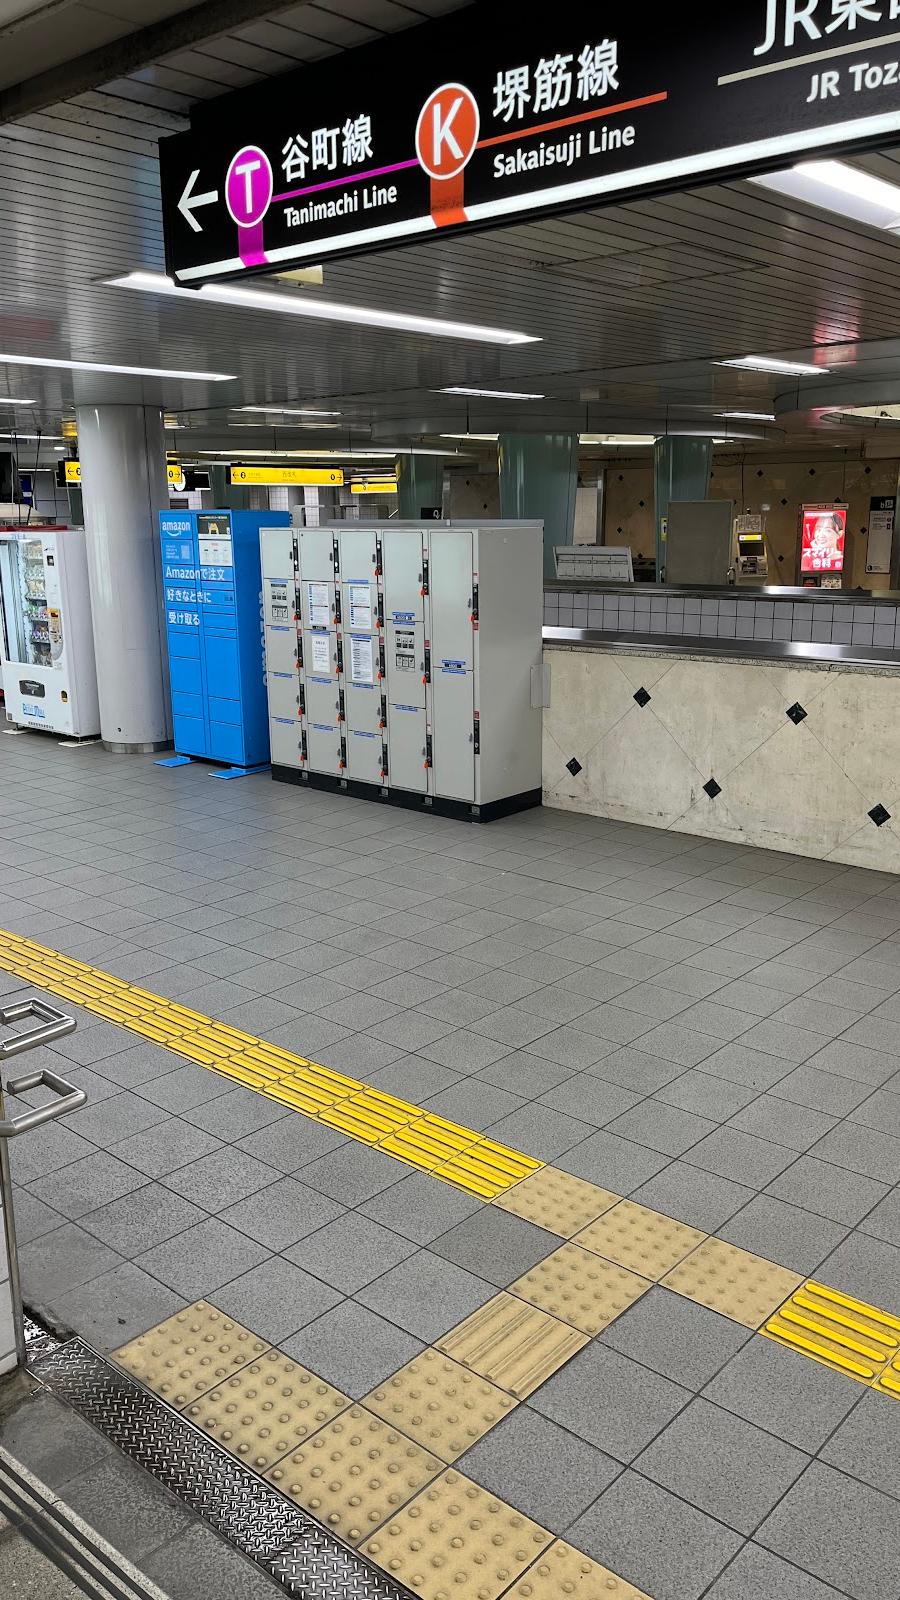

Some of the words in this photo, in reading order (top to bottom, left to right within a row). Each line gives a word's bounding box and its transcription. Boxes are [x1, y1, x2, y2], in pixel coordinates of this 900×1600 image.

[753, 0, 900, 56] JR
[492, 38, 619, 122] 堺筋線
[806, 71, 840, 103] JR
[848, 61, 900, 92] Toz
[281, 113, 373, 183] 谷町線
[432, 95, 465, 167] K
[493, 133, 582, 177] Sakaisuji
[589, 123, 636, 155] Line
[235, 160, 261, 213] T
[284, 192, 359, 227] Tanimachi
[363, 183, 397, 209] Line
[162, 521, 191, 532] amazon
[166, 566, 225, 581] Amazonで注文
[167, 588, 212, 603] 好きなときに
[168, 611, 201, 626] 受け取る
